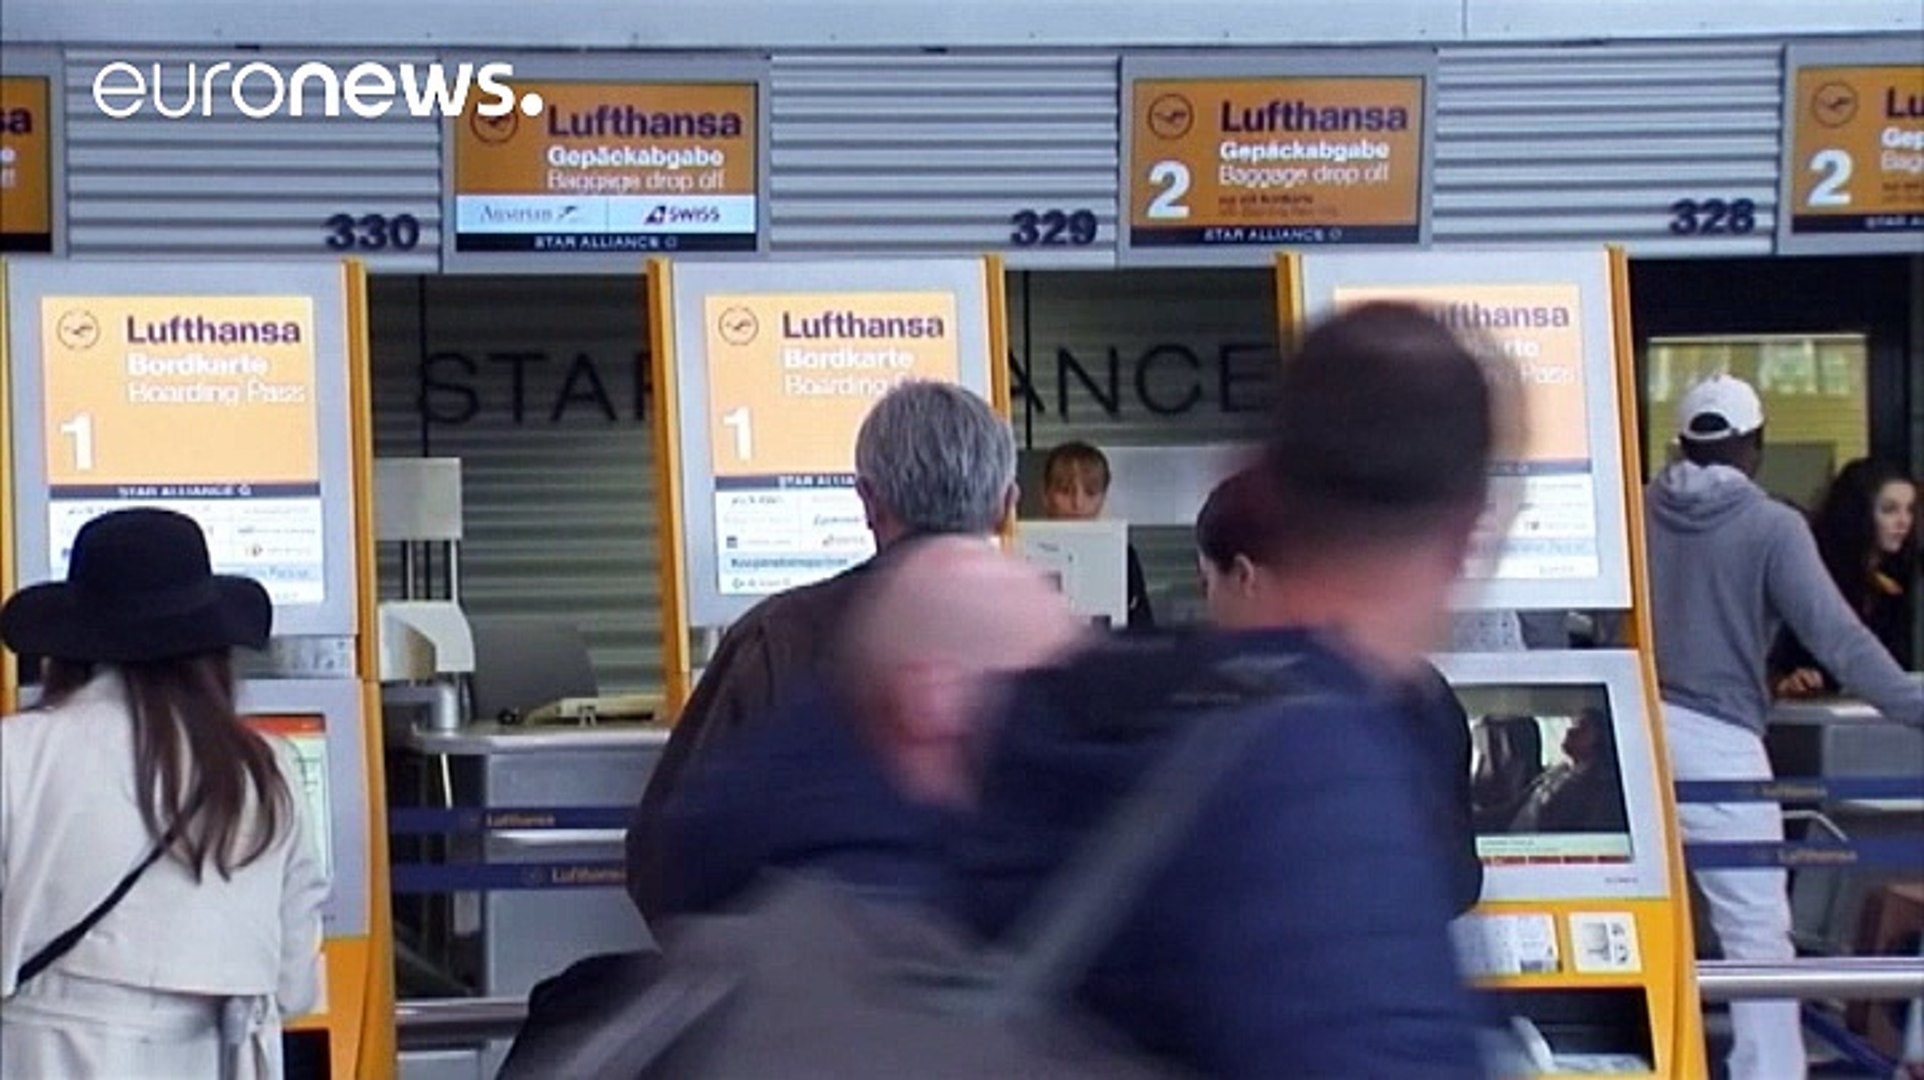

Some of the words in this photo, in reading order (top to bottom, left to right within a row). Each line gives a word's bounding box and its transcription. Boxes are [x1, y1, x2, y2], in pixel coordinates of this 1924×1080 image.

[547, 104, 742, 137] Lufthansa
[1220, 100, 1409, 132] Lufthansa
[547, 145, 724, 168] Gepäckabgabe
[1219, 139, 1390, 163] Gepäckabgabe
[646, 169, 694, 192] drop
[1147, 160, 1191, 219] 2
[1219, 165, 1308, 188] Baggage
[1313, 165, 1360, 187] drop
[1807, 149, 1852, 206] 2
[1010, 208, 1098, 247] 329
[1669, 198, 1756, 236] 328
[325, 214, 420, 251] 330
[534, 236, 576, 249] STAR
[581, 236, 658, 249] ALLIANCE
[1204, 229, 1244, 241] STAR
[1250, 229, 1325, 241] ALLIANCE
[127, 315, 301, 345] Lufthansa
[782, 311, 944, 339] Lufthansa
[128, 353, 268, 376] Bordkarte
[784, 346, 914, 369] Bordkarte
[128, 382, 239, 406] Boarding
[248, 379, 305, 403] Pass
[60, 412, 93, 470] 1
[723, 406, 752, 461] 1
